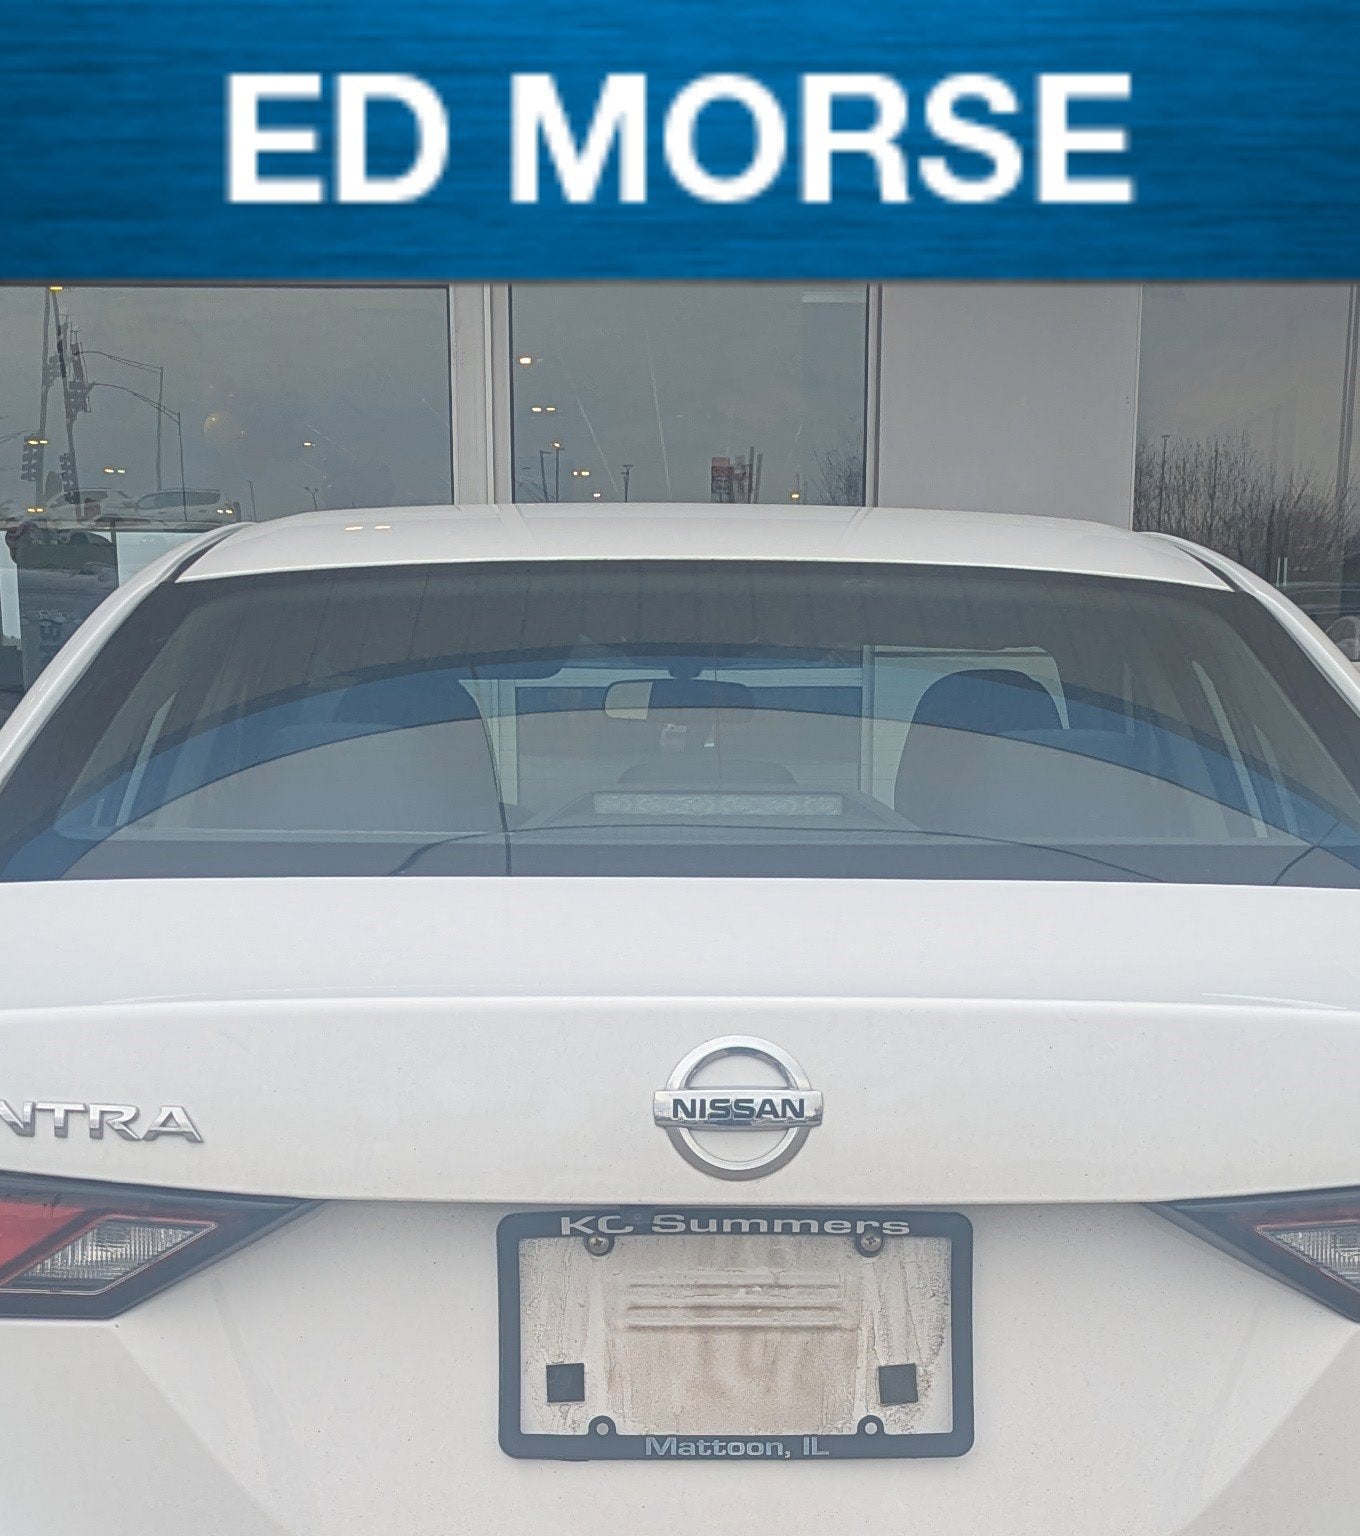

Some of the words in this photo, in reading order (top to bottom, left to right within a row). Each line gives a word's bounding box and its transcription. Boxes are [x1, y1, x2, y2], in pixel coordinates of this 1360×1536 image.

[671, 1097, 806, 1120] NISSAN
[560, 1215, 634, 1236] KC
[651, 1213, 911, 1236] Summers
[644, 1437, 792, 1459] Mattoon,
[803, 1437, 830, 1457] IL
